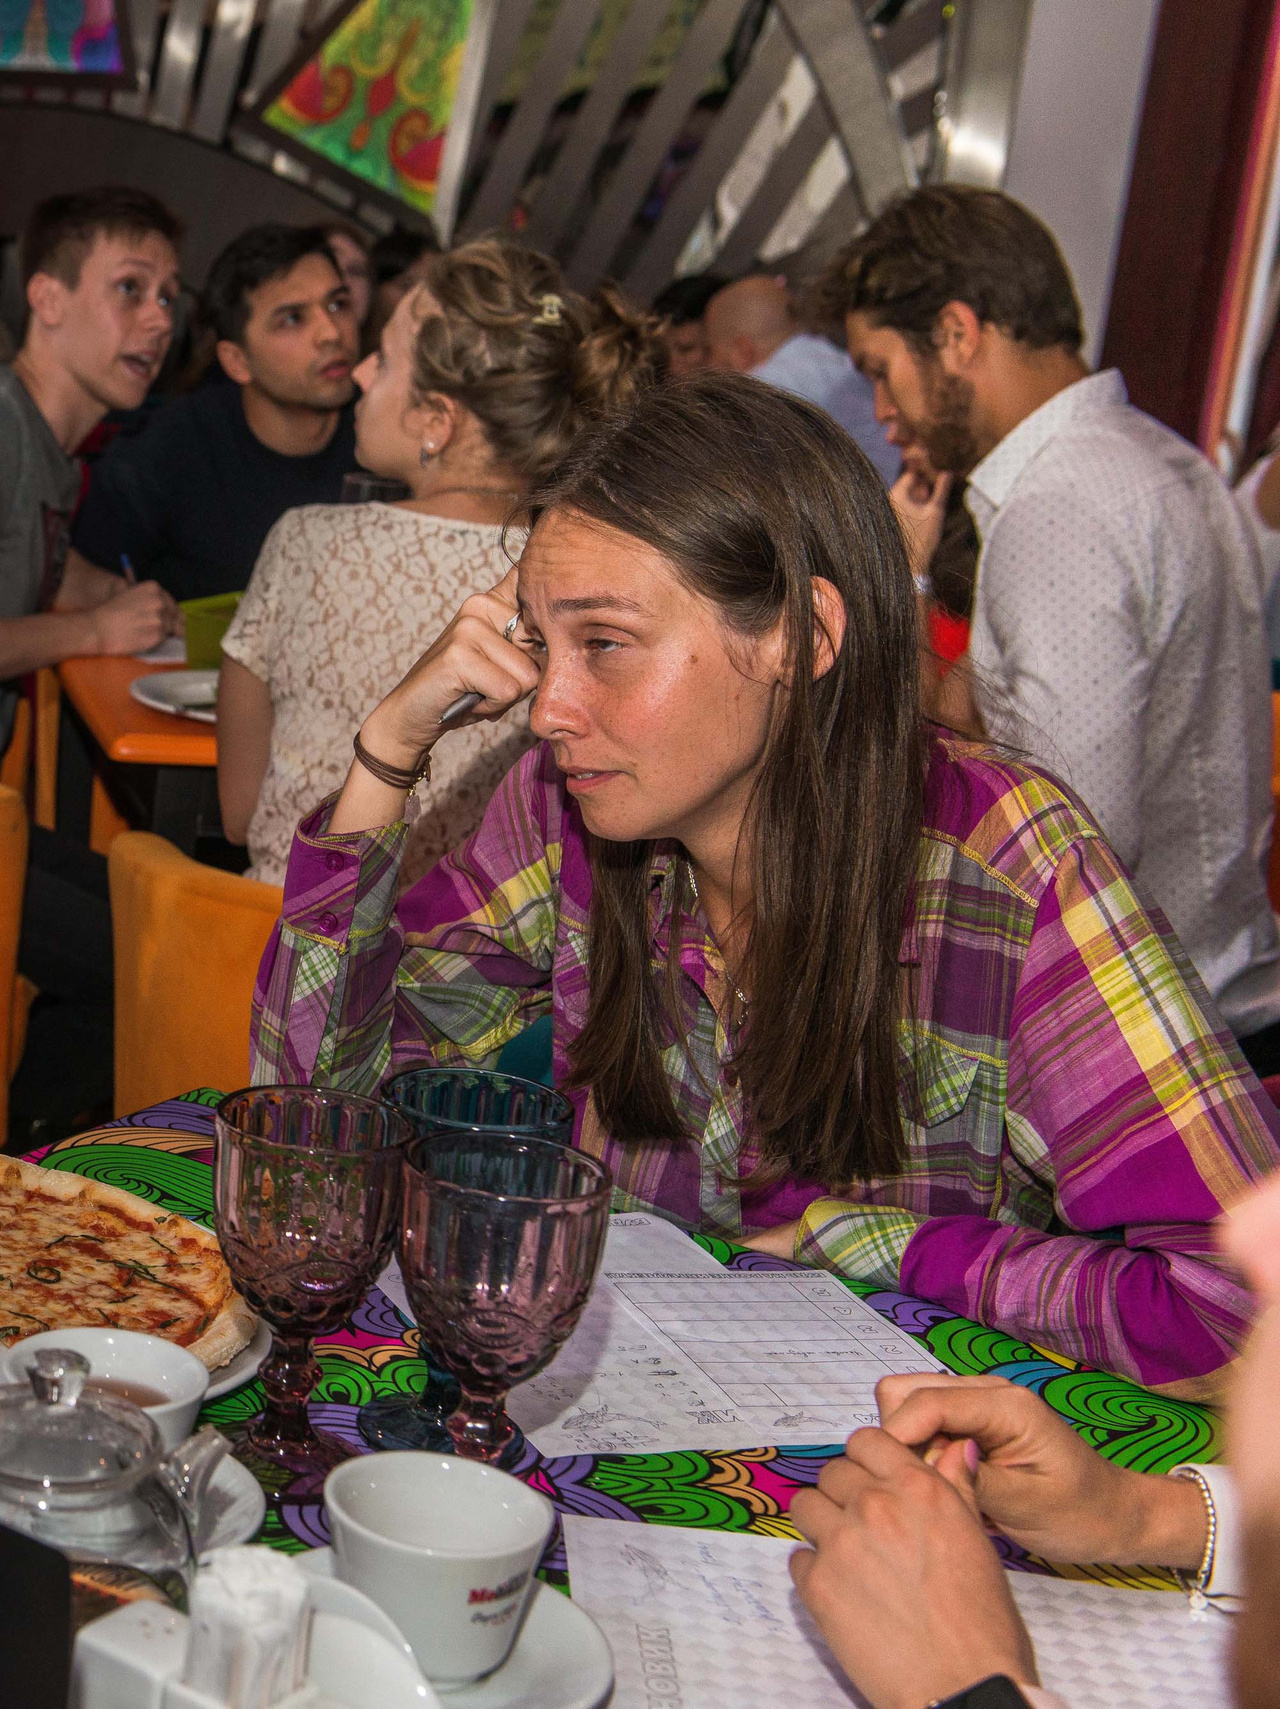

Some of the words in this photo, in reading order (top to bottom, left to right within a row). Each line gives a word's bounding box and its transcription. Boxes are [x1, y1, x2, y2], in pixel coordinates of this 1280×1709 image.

[857, 1325, 879, 1335] 3
[879, 1344, 903, 1355] 2
[635, 1623, 684, 1709] НОВИК
